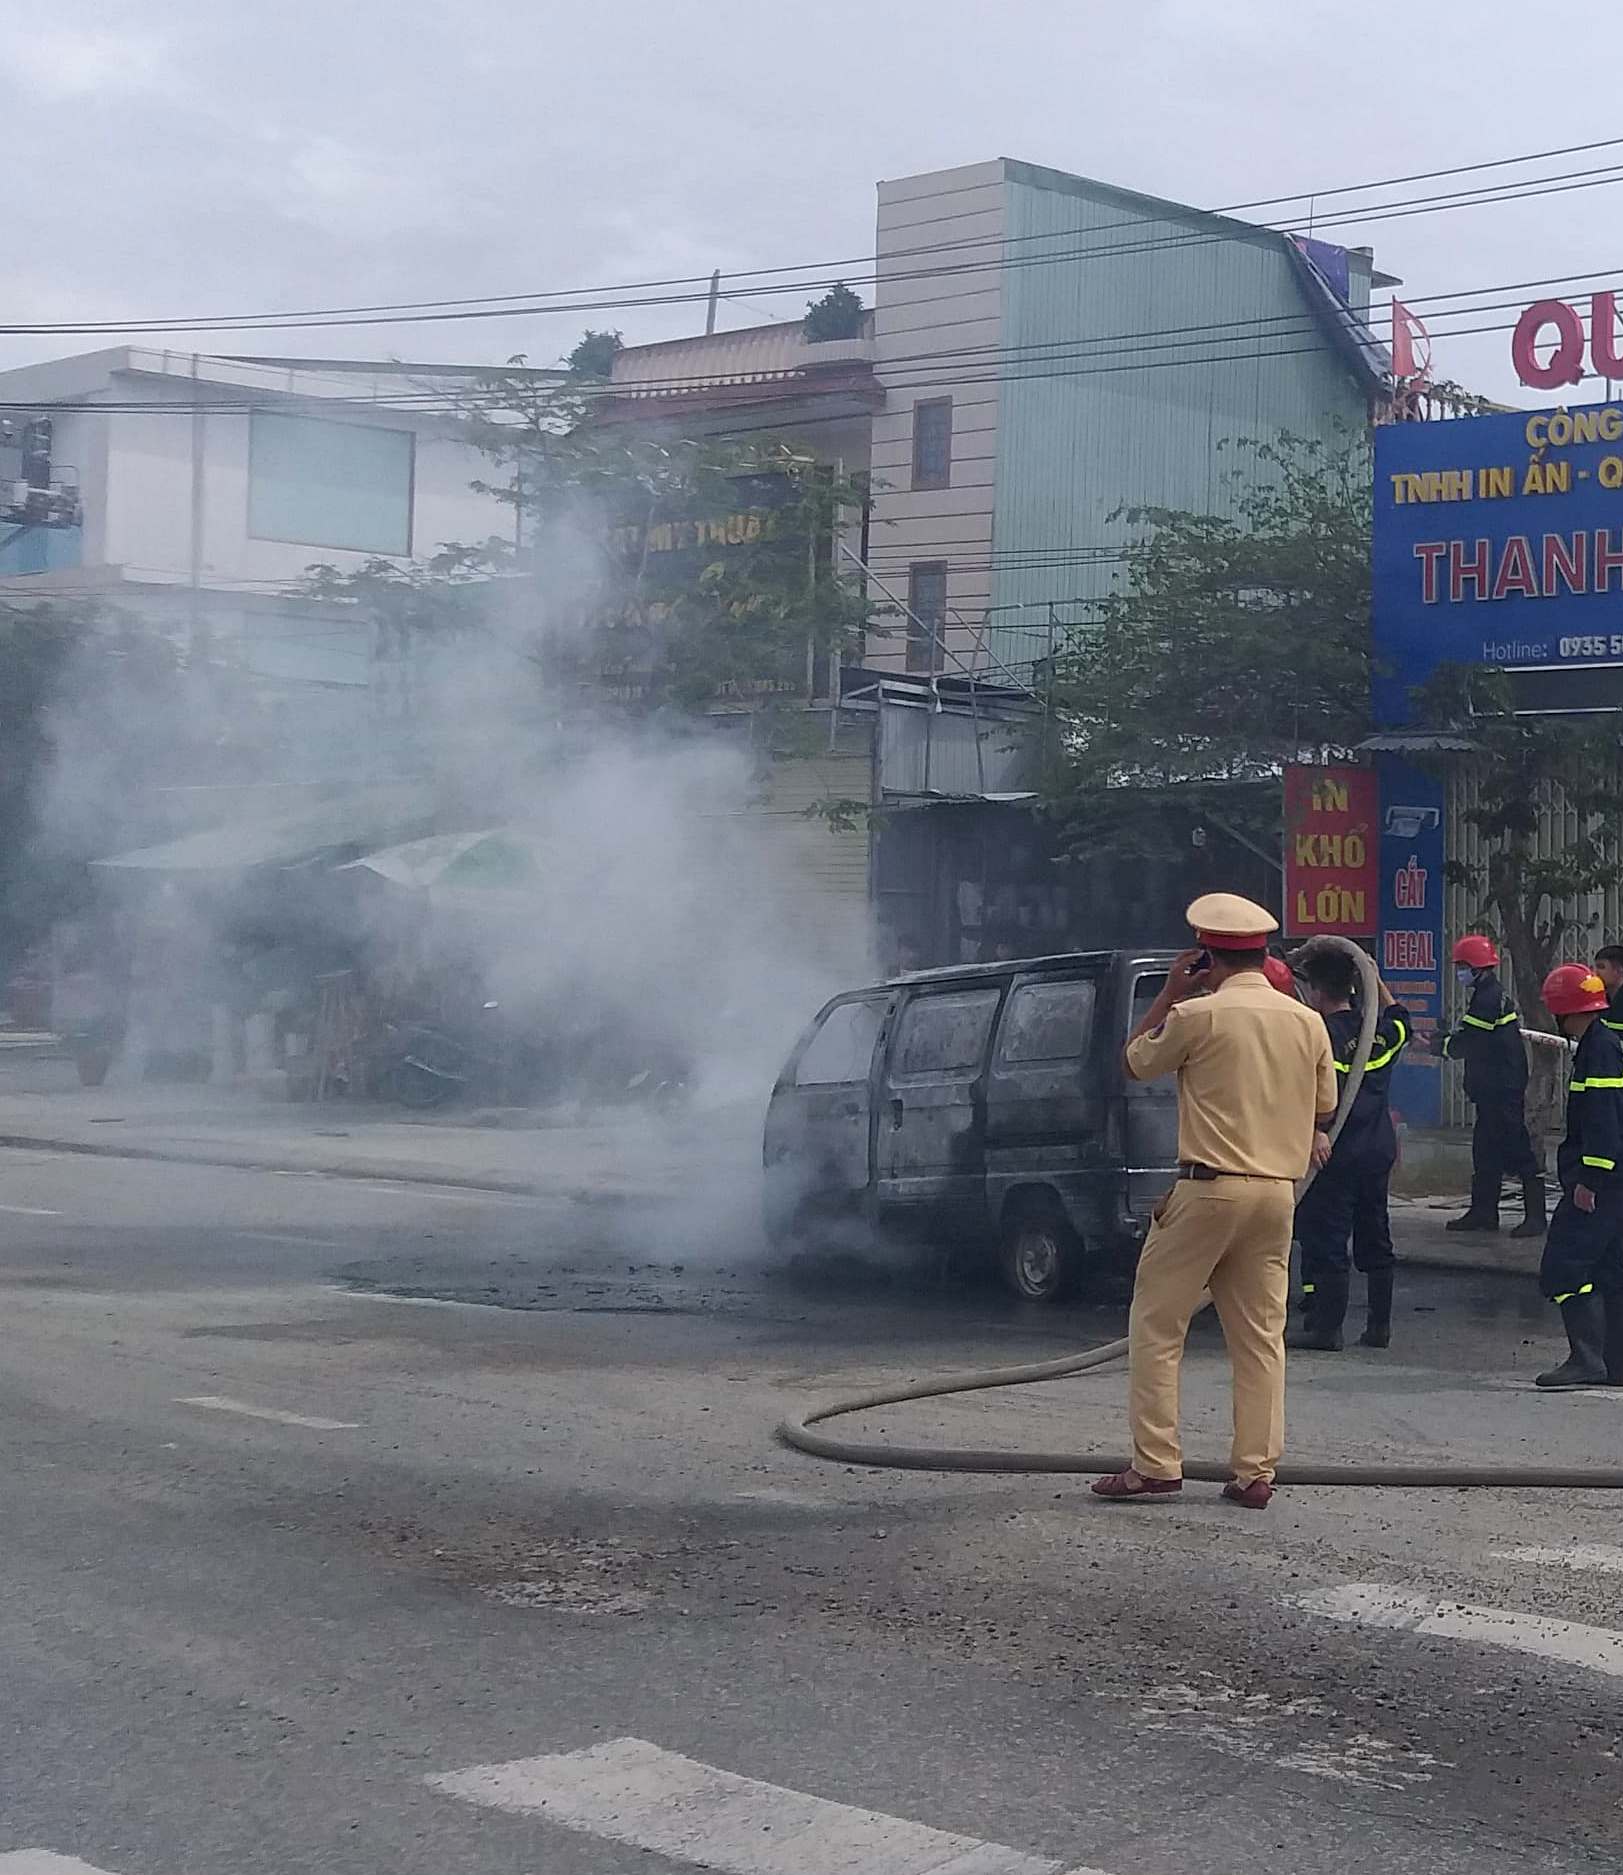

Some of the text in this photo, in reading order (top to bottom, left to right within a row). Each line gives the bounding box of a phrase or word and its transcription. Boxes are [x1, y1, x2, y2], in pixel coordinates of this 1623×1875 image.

[1390, 469, 1473, 505] TNHH
[1478, 467, 1514, 499] IN
[1522, 449, 1570, 497] ẤN
[1483, 640, 1548, 663] Hotline:
[1559, 634, 1607, 659] 0935
[1312, 779, 1349, 813] IN
[1295, 822, 1369, 869] KHỔ
[1297, 881, 1366, 924] LỚN
[1383, 930, 1437, 972] DECAL
